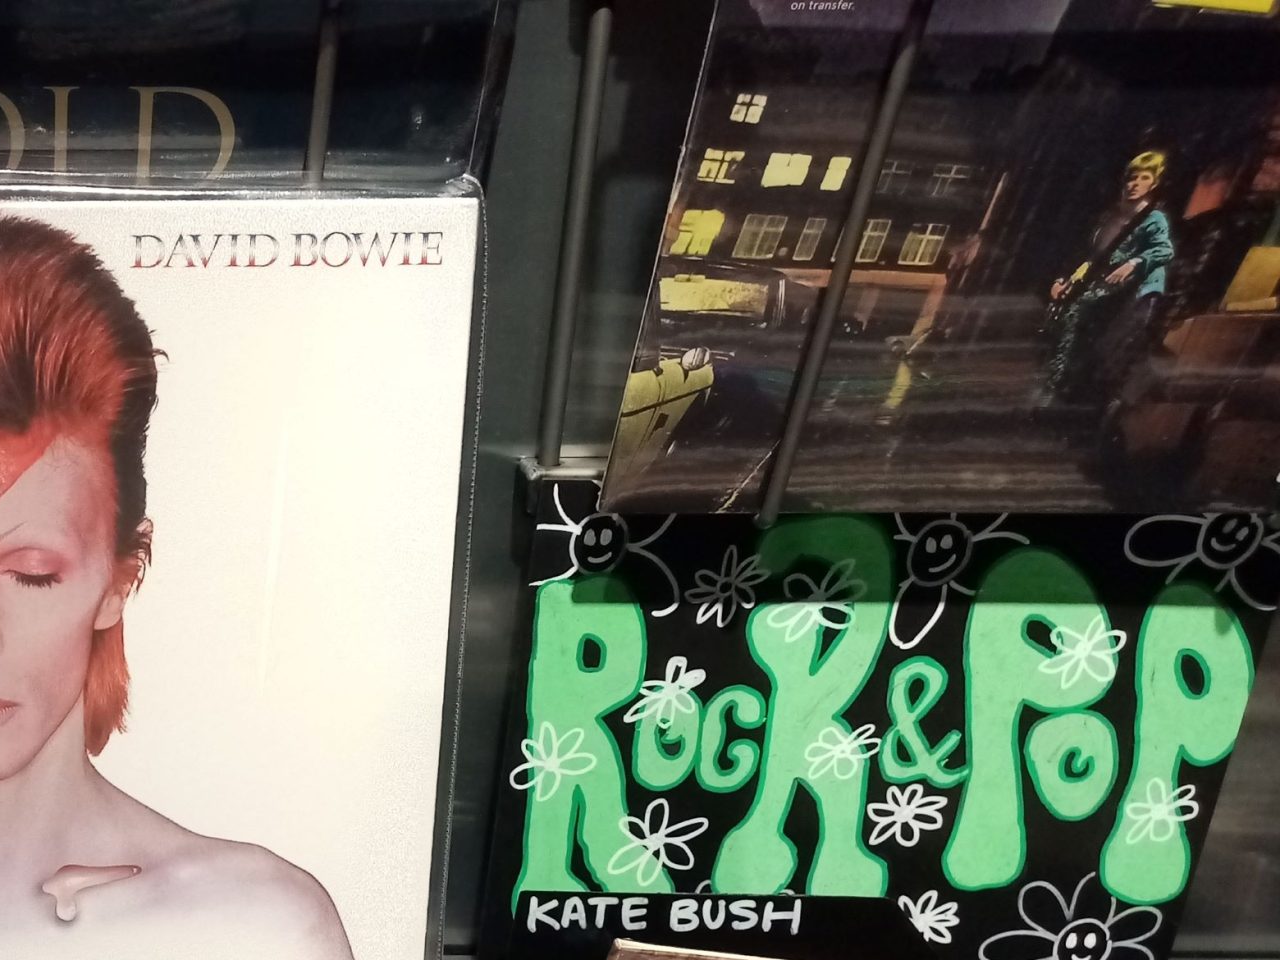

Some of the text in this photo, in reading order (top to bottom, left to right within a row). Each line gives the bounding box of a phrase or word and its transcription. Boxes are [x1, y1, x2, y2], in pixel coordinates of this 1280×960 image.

[790, 1, 805, 10] on
[130, 231, 443, 268] DAVID BOWIE
[879, 655, 970, 786] &
[526, 896, 802, 935] KATE BUSH
